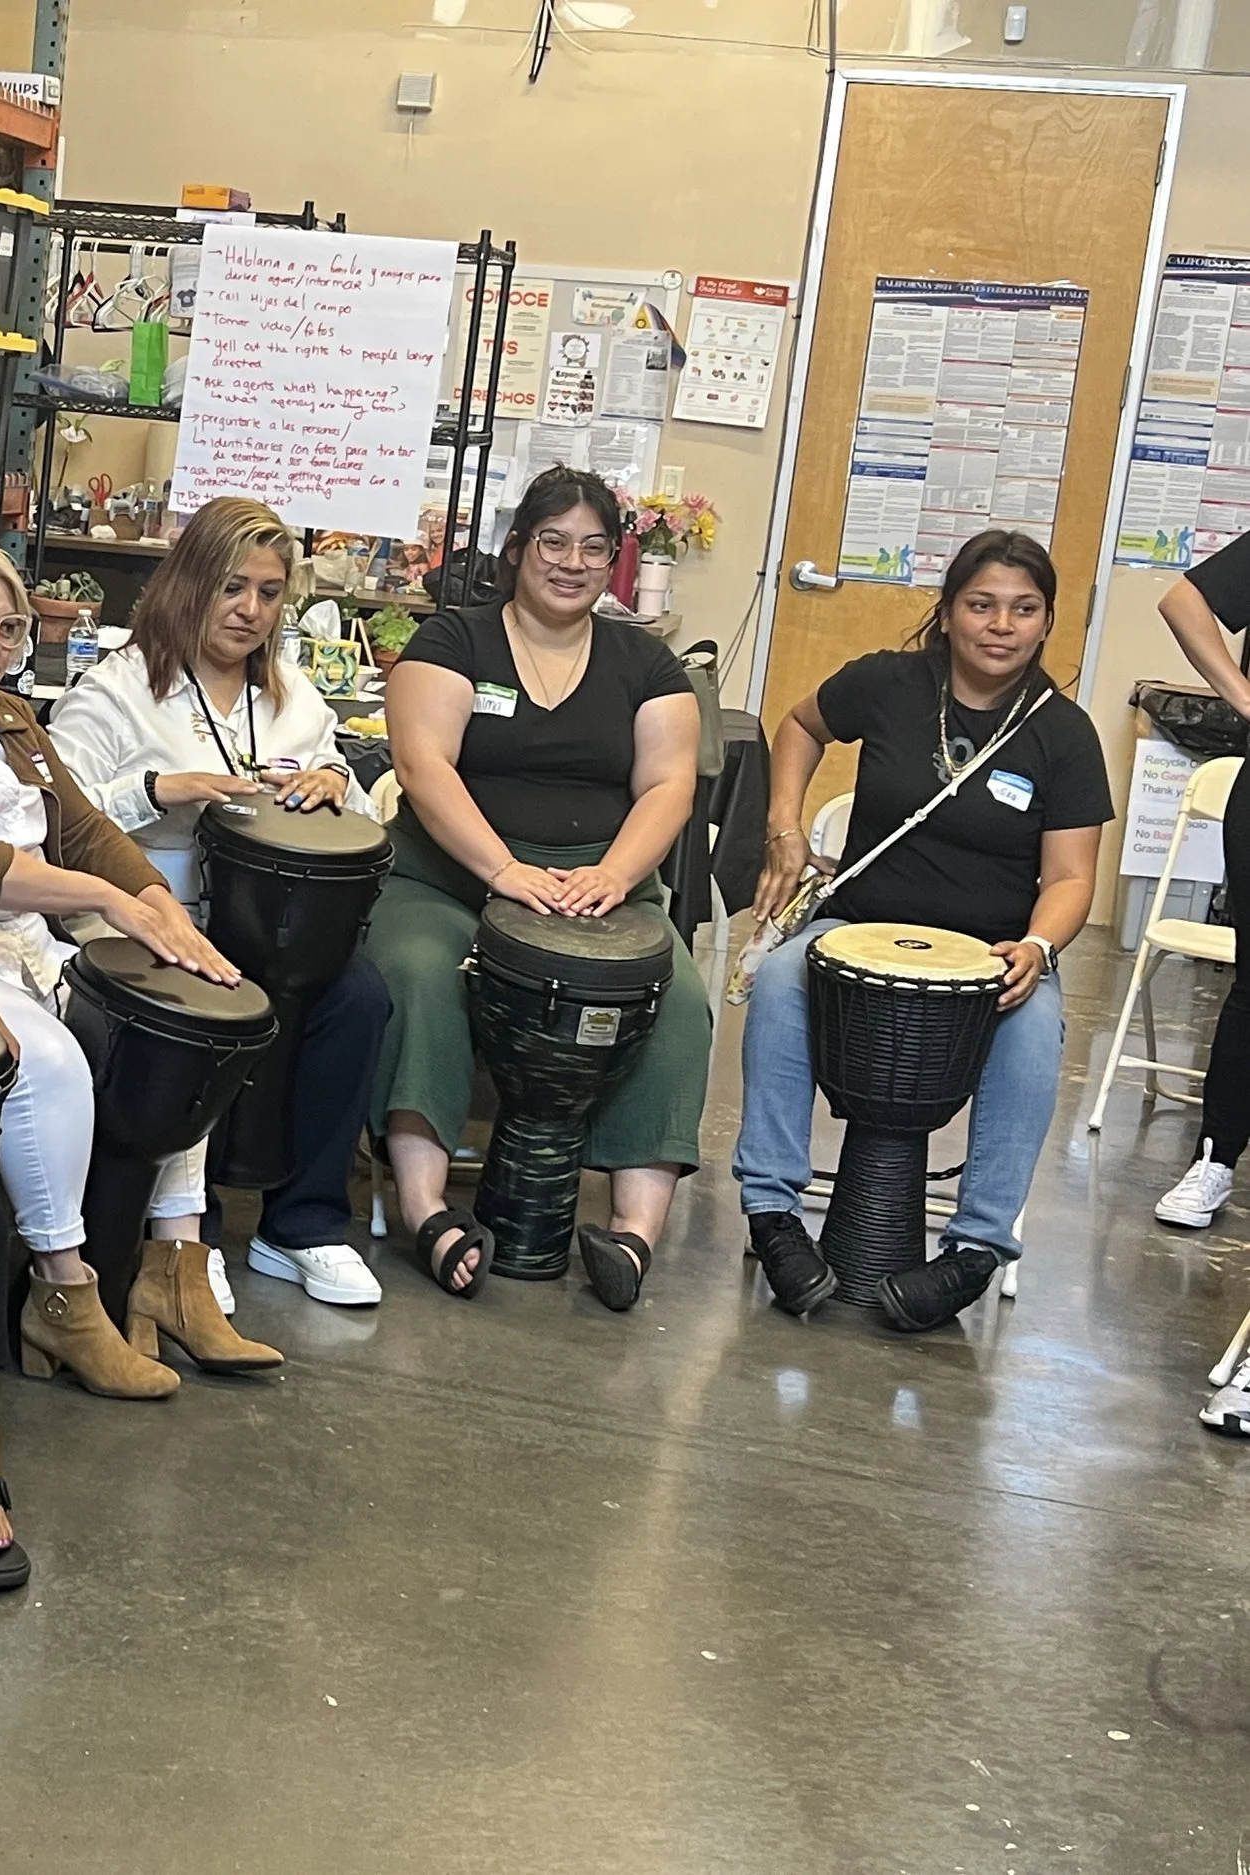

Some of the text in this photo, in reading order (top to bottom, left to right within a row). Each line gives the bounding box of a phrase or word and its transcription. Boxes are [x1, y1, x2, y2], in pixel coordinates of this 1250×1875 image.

[417, 273, 441, 285] para
[284, 293, 306, 310] del
[314, 302, 351, 316] campo
[483, 339, 518, 355] TS
[267, 343, 288, 353] the
[340, 345, 352, 356] to
[362, 349, 397, 364] people
[407, 349, 433, 367] being
[212, 359, 262, 369] arrested
[233, 380, 274, 395] agents
[271, 399, 315, 414] agency
[345, 446, 368, 460] para
[1145, 755, 1186, 768] Recycle
[1143, 770, 1158, 779] No
[1142, 783, 1174, 795] Thank
[1136, 830, 1150, 839] No
